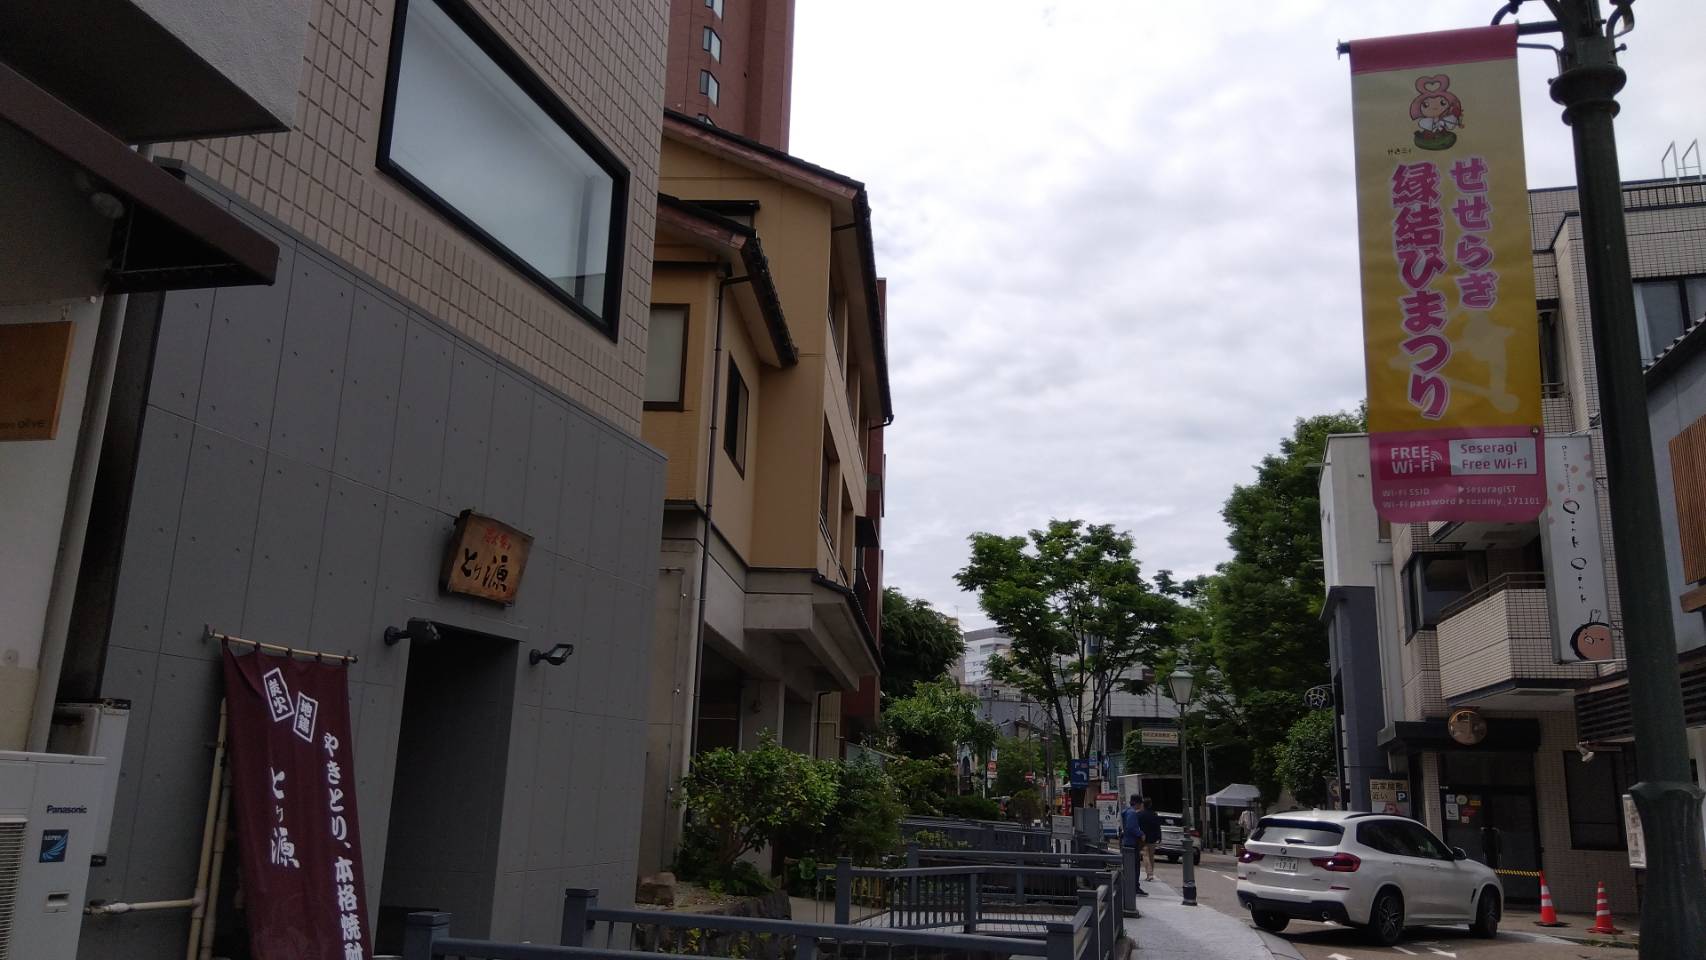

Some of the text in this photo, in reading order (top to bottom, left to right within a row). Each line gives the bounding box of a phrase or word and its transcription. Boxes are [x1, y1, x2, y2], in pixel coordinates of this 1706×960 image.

[1451, 157, 1498, 310] せせらぎ
[1391, 161, 1450, 421] 縁結びまつり
[1391, 445, 1430, 460] FREE
[1460, 441, 1518, 456] Seseragi
[1391, 459, 1436, 474] Wi-Fi
[1462, 458, 1528, 470] Free Wi-Fi
[1409, 487, 1431, 496] SSID
[1409, 498, 1456, 509] password
[1397, 792, 1407, 801] P
[46, 804, 87, 814] Panasonic
